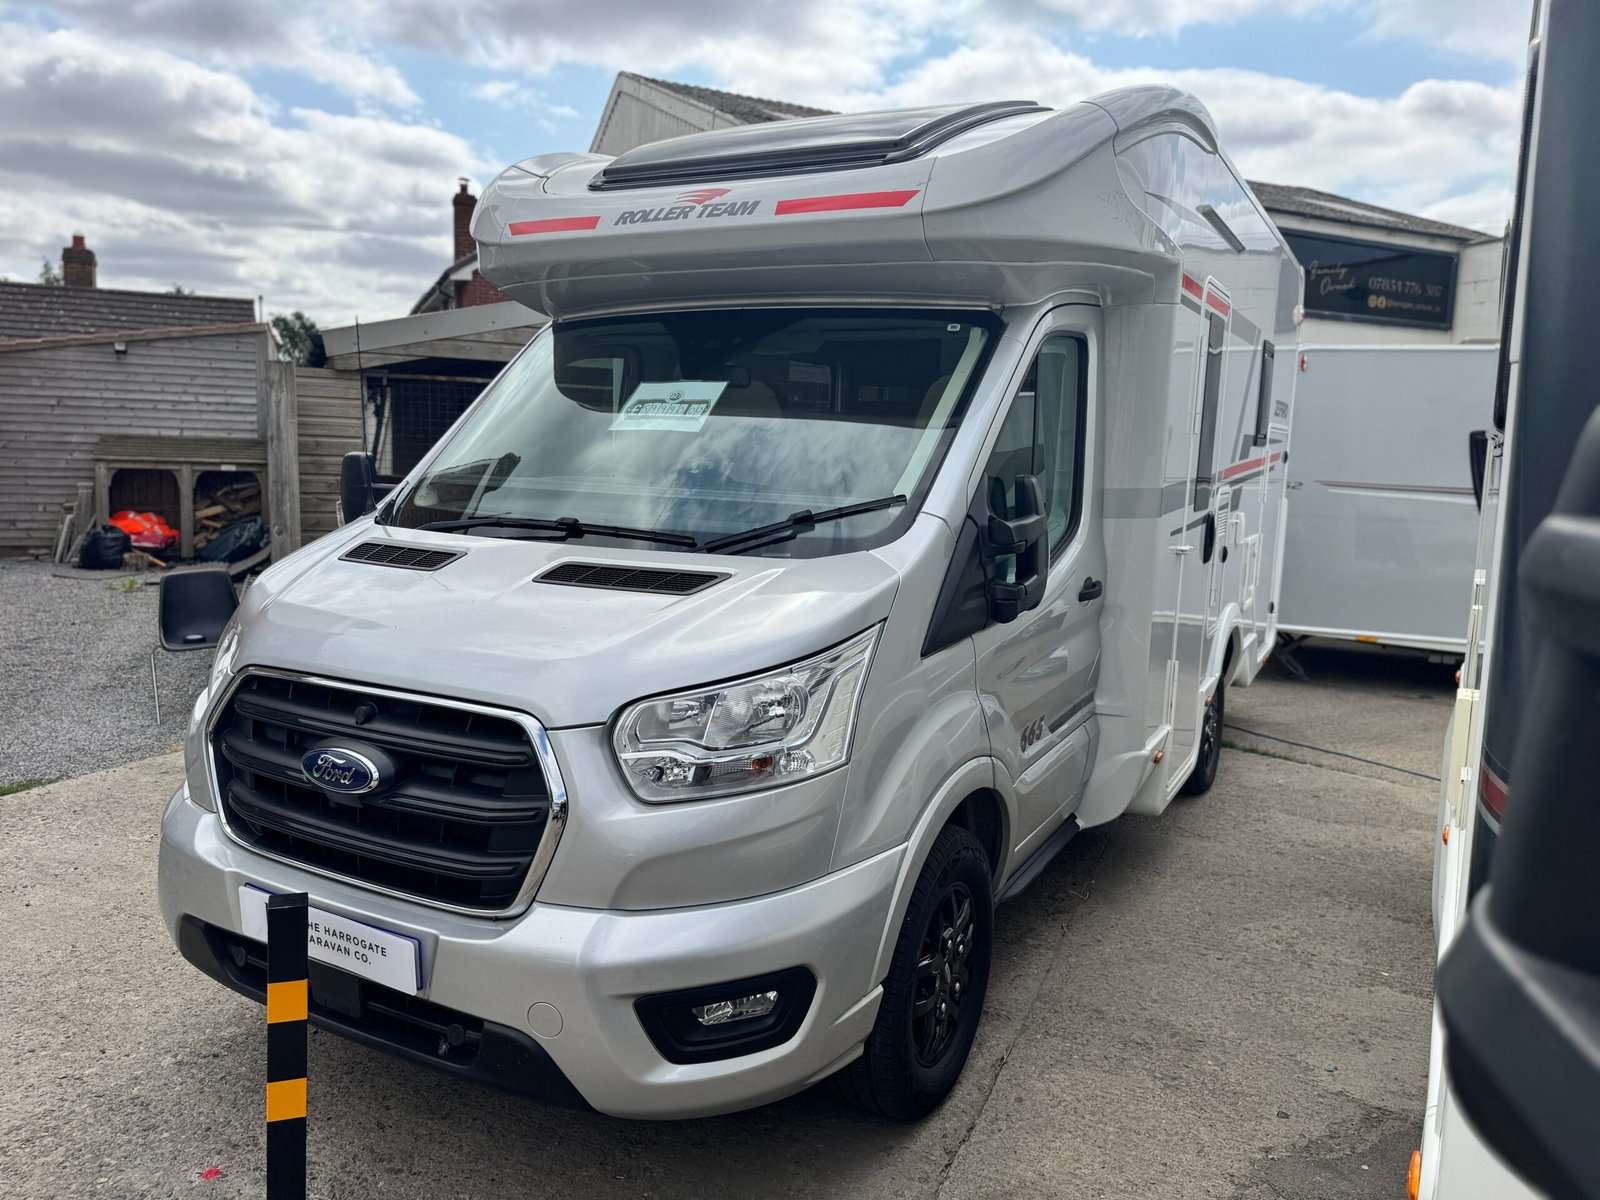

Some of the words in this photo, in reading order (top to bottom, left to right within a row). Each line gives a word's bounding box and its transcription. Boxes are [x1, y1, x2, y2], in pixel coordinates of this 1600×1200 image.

[613, 205, 697, 226] ROLLER
[696, 200, 761, 219] TEAM
[313, 755, 355, 784] Ford
[309, 935, 350, 957] ARAVAN
[354, 950, 372, 965] CO.
[324, 925, 387, 957] HARROGATE
